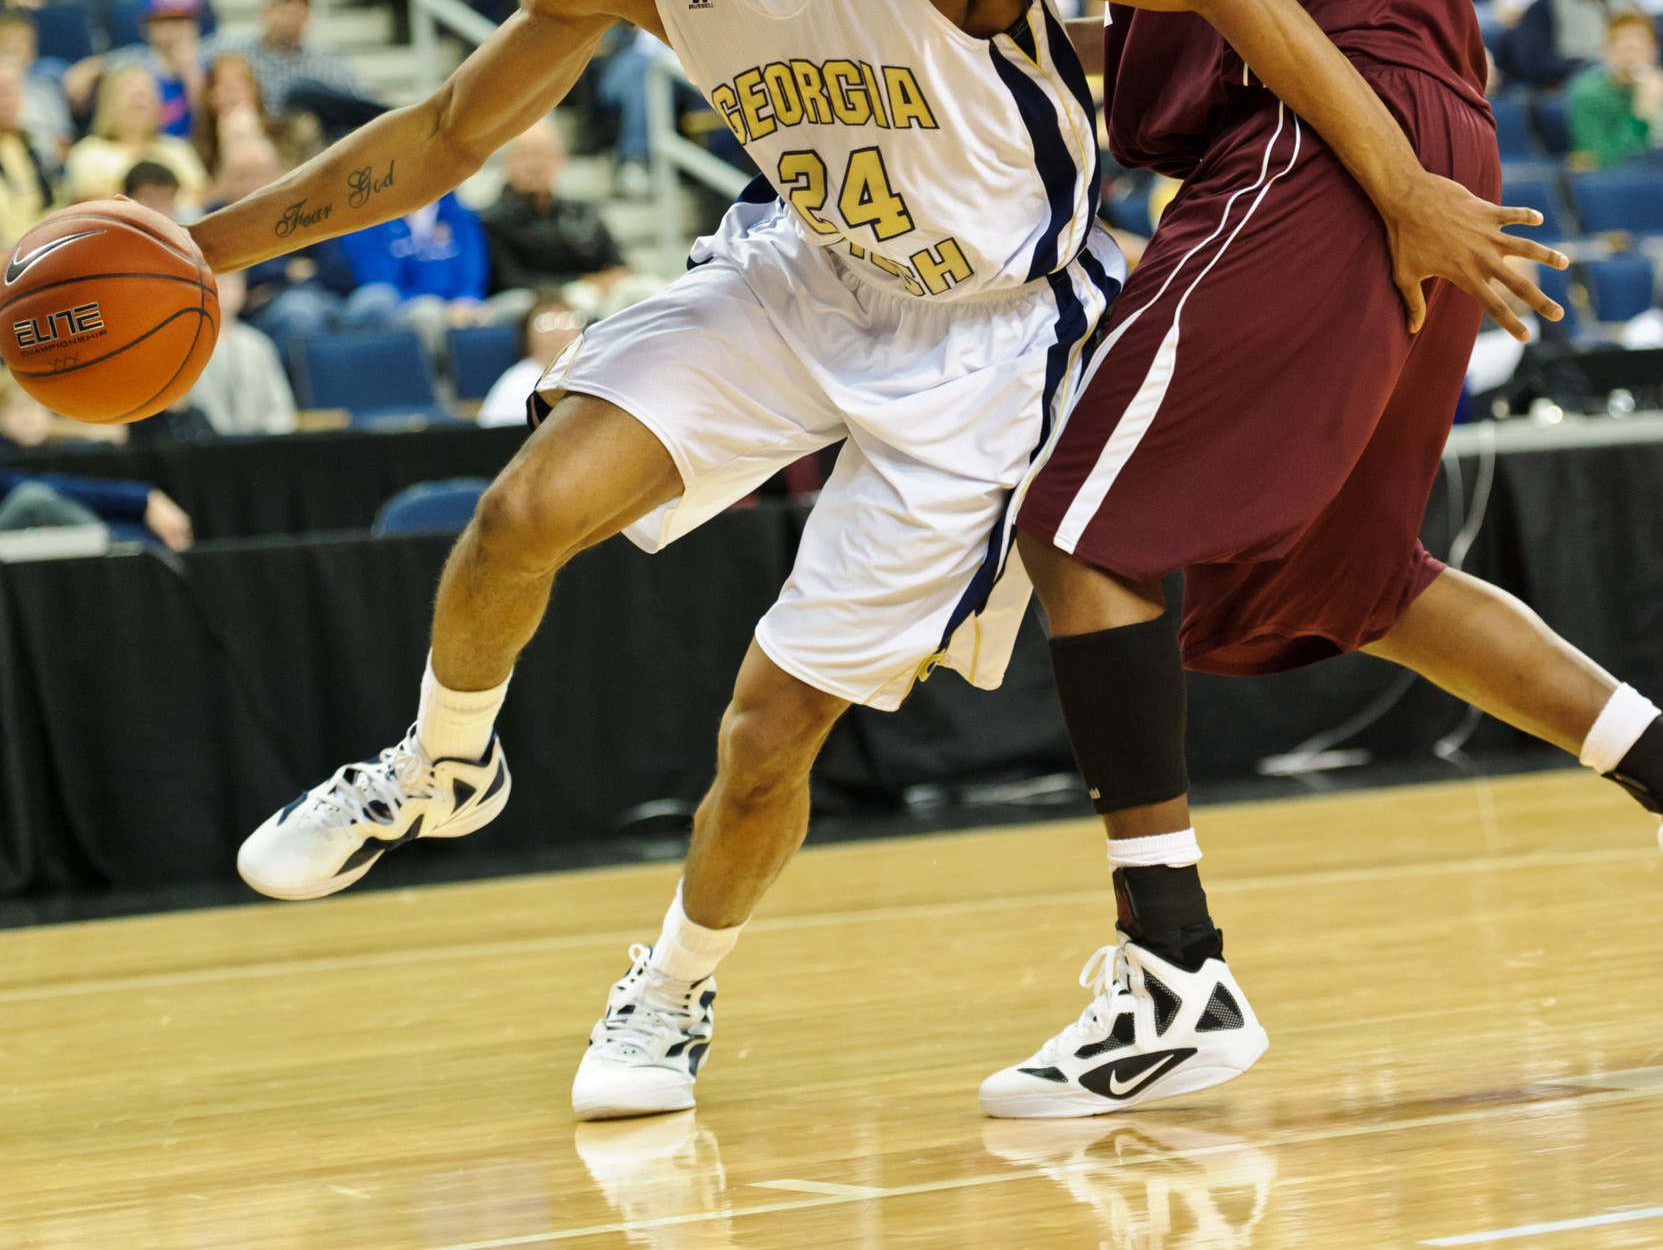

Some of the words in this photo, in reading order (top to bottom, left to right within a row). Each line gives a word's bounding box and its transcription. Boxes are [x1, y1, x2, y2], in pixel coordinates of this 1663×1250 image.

[711, 58, 940, 146] GEORGIA
[275, 198, 333, 238] Fear
[347, 159, 396, 209] God
[777, 146, 916, 243] 24
[13, 301, 105, 349] ELITE
[21, 329, 108, 357] CHAMPIONSHIP
